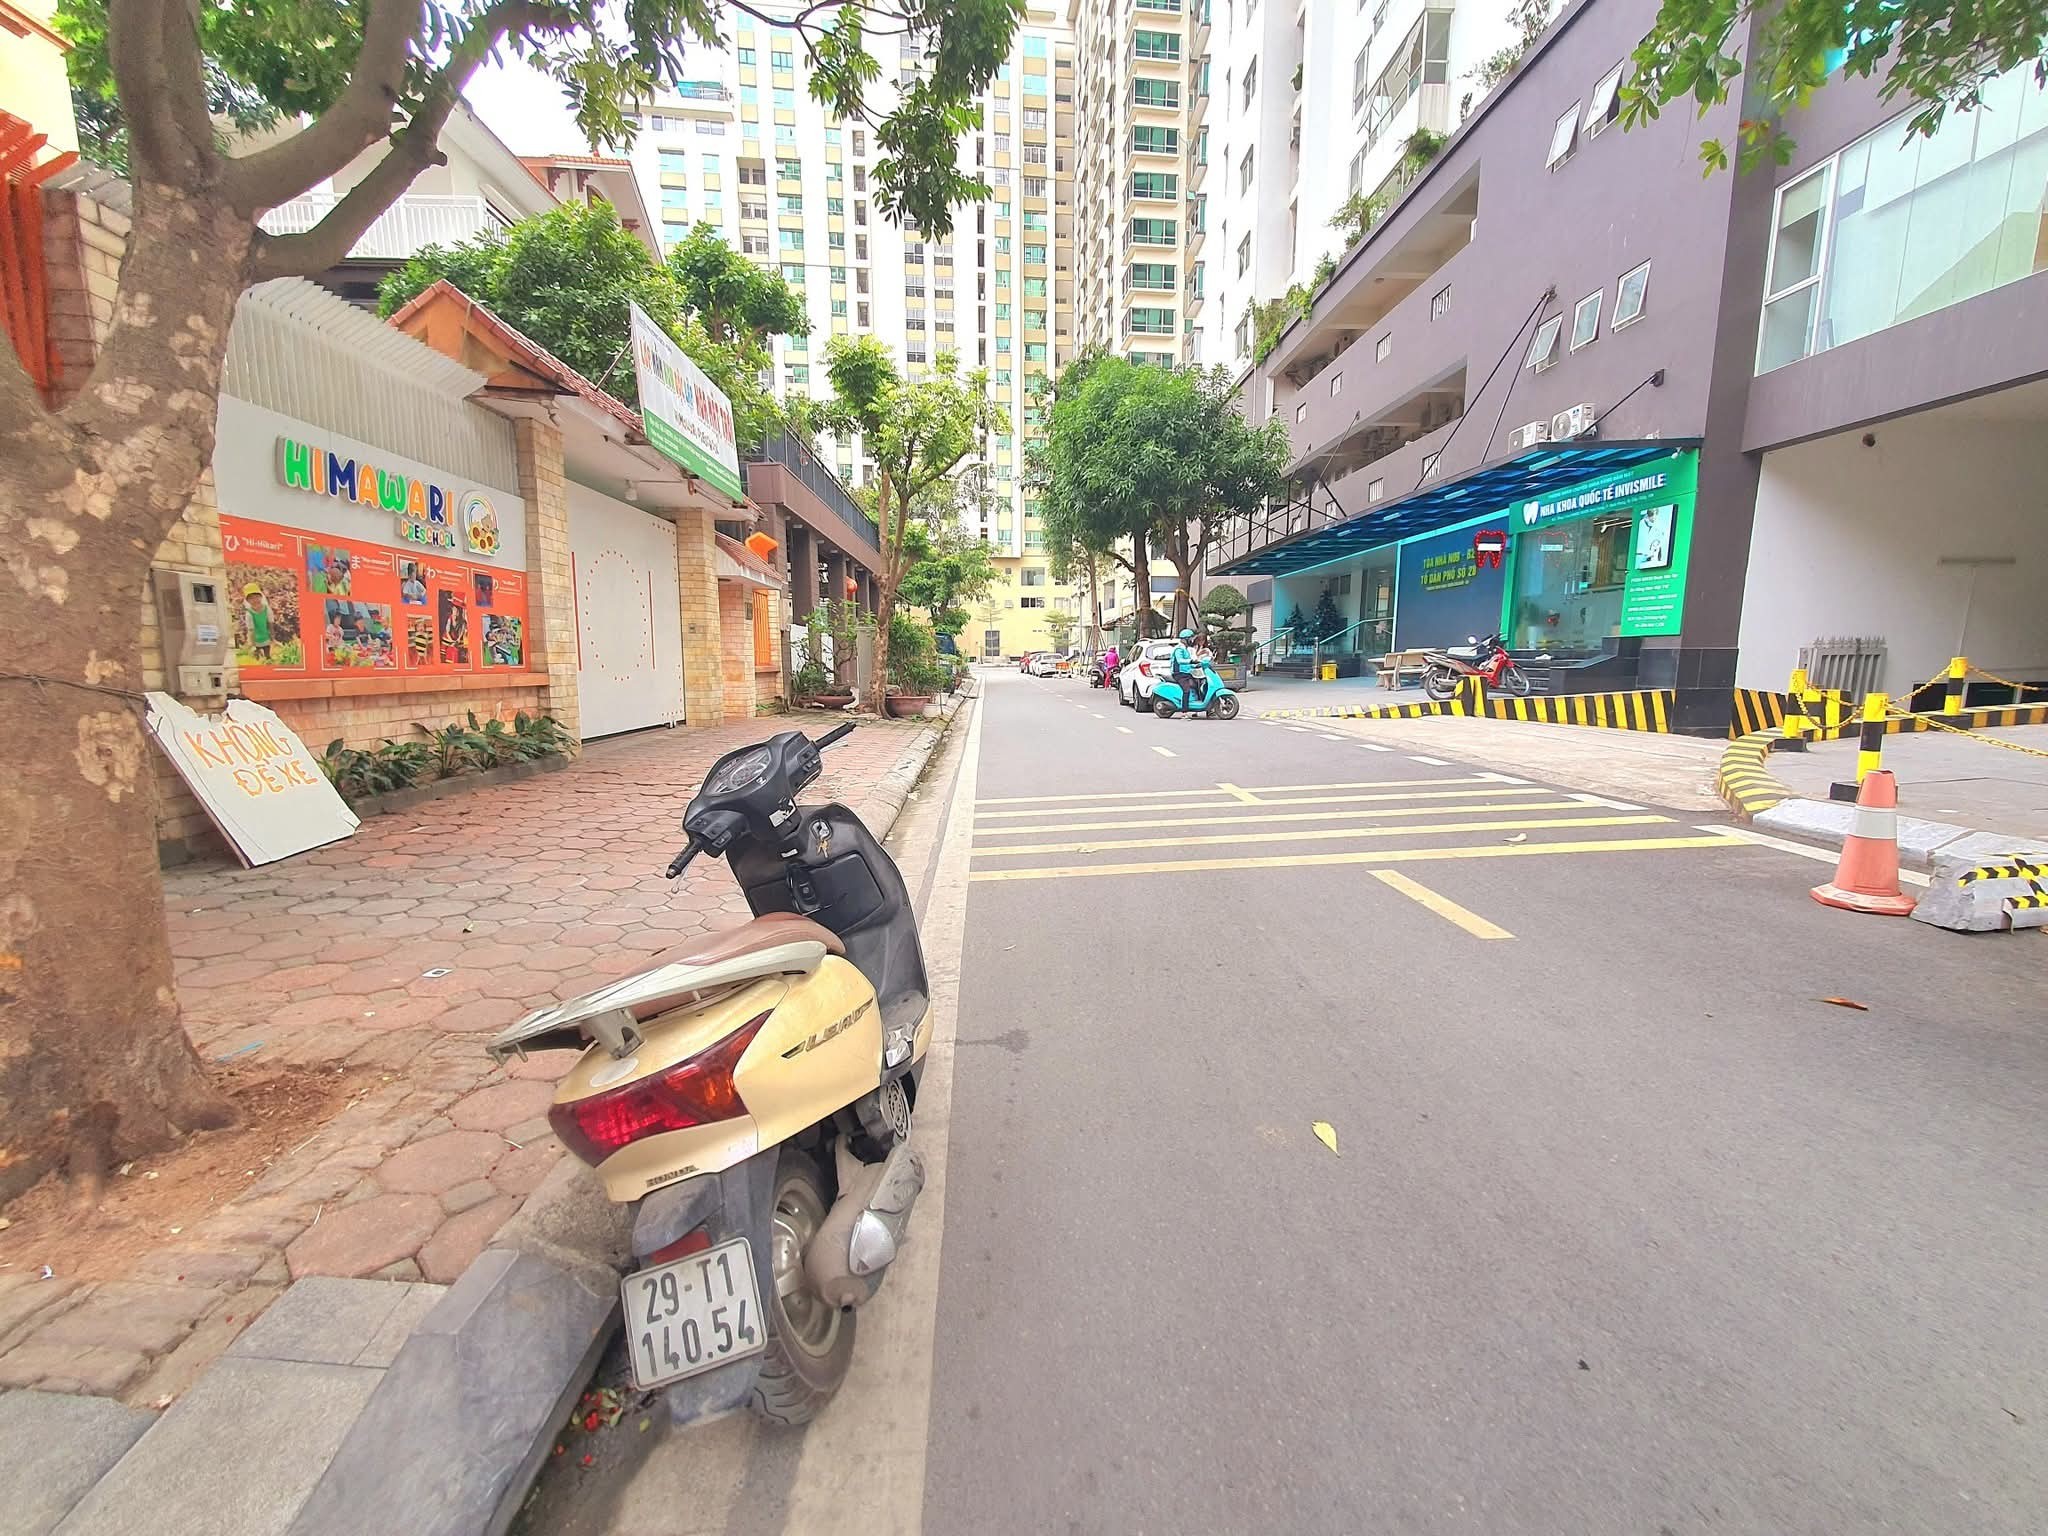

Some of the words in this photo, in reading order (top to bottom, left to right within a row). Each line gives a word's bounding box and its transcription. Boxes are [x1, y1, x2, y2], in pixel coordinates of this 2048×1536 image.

[283, 438, 456, 527] HIMAWARI
[1539, 503, 1555, 517] NHA
[1557, 498, 1578, 514] KHOA
[1579, 488, 1602, 509] QUỐC
[1603, 482, 1616, 501] TẾ
[1615, 473, 1667, 498] INVISMILE
[400, 518, 456, 549] PRESCHOOL
[183, 713, 294, 769] KHÔNG
[275, 760, 319, 788] XE
[642, 1252, 735, 1325] 29-T1
[641, 1299, 756, 1377] 140.54
